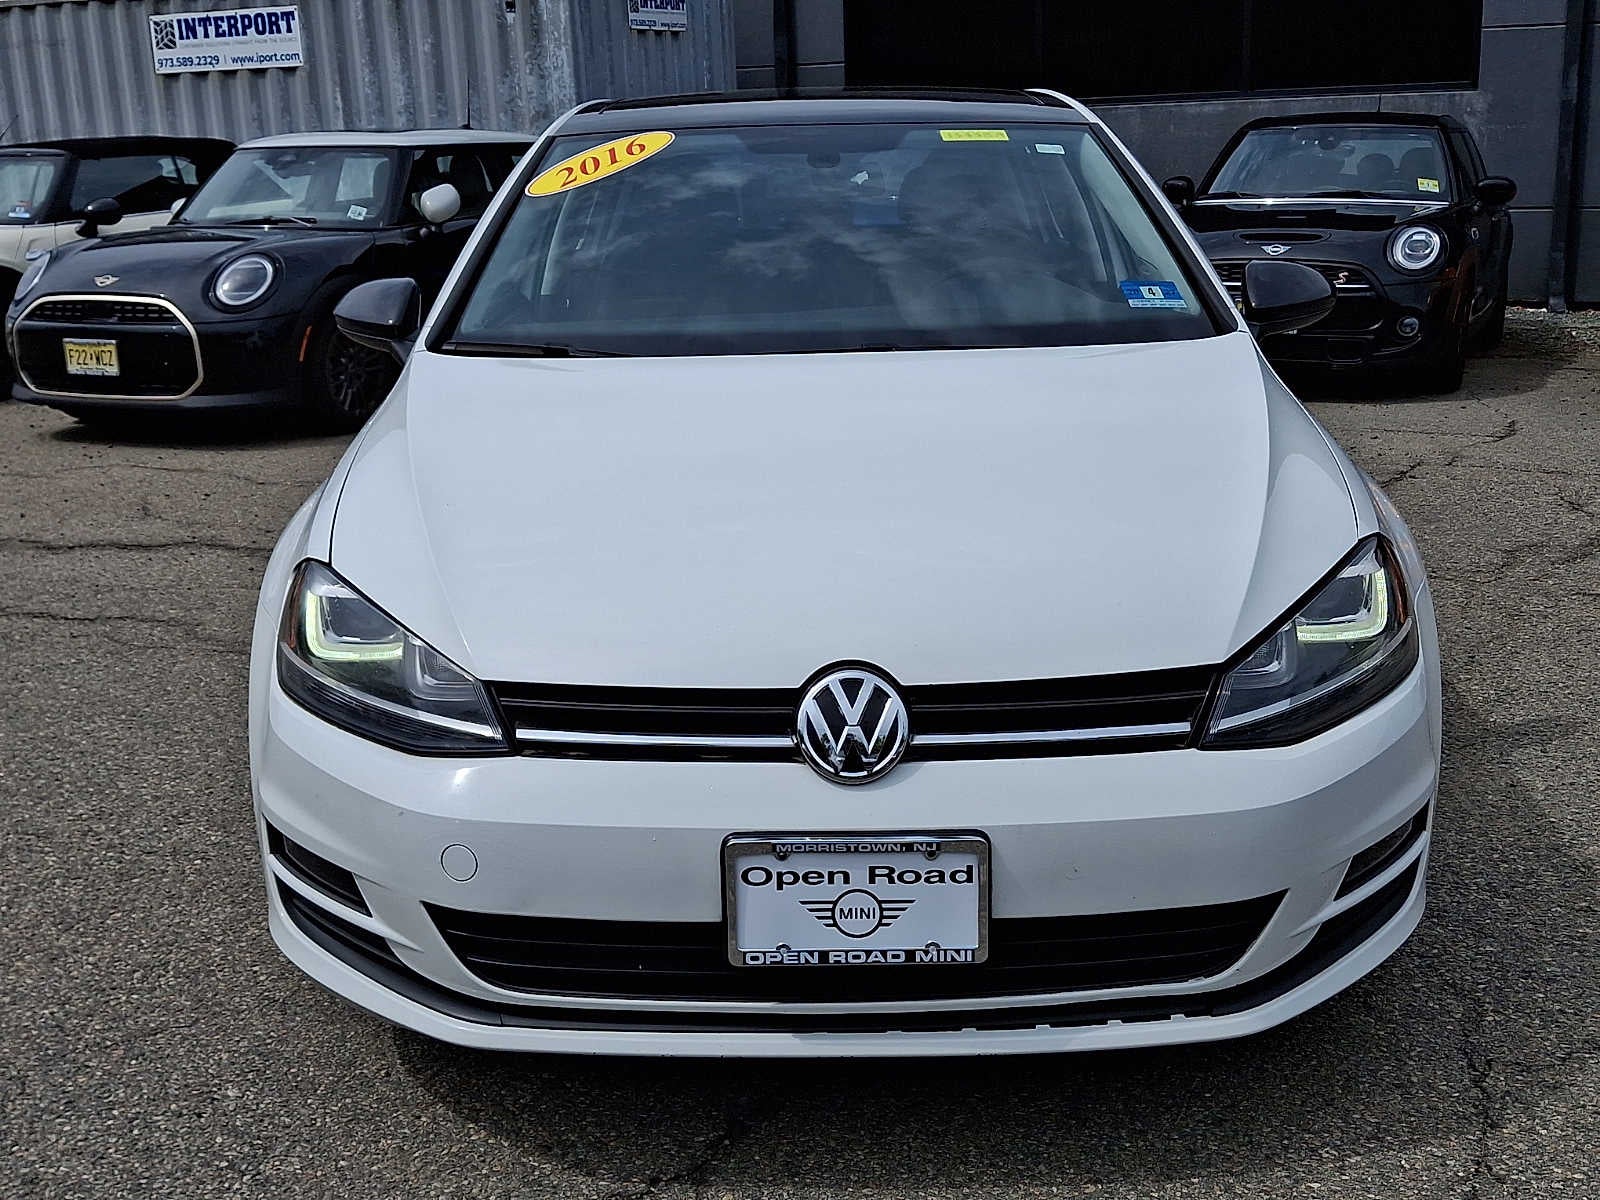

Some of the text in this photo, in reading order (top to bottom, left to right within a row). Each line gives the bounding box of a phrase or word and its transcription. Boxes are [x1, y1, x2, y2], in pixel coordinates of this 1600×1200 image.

[176, 10, 296, 41] INTERPORT
[157, 52, 300, 68] 973.589.2329 www.iport.com
[556, 137, 646, 188] 2016
[1147, 287, 1156, 297] 4
[775, 843, 937, 853] MORRISTOWN, NJ
[740, 864, 975, 891] Open Road
[839, 906, 877, 921] MINI
[745, 950, 973, 965] OPEN ROAD MINI
